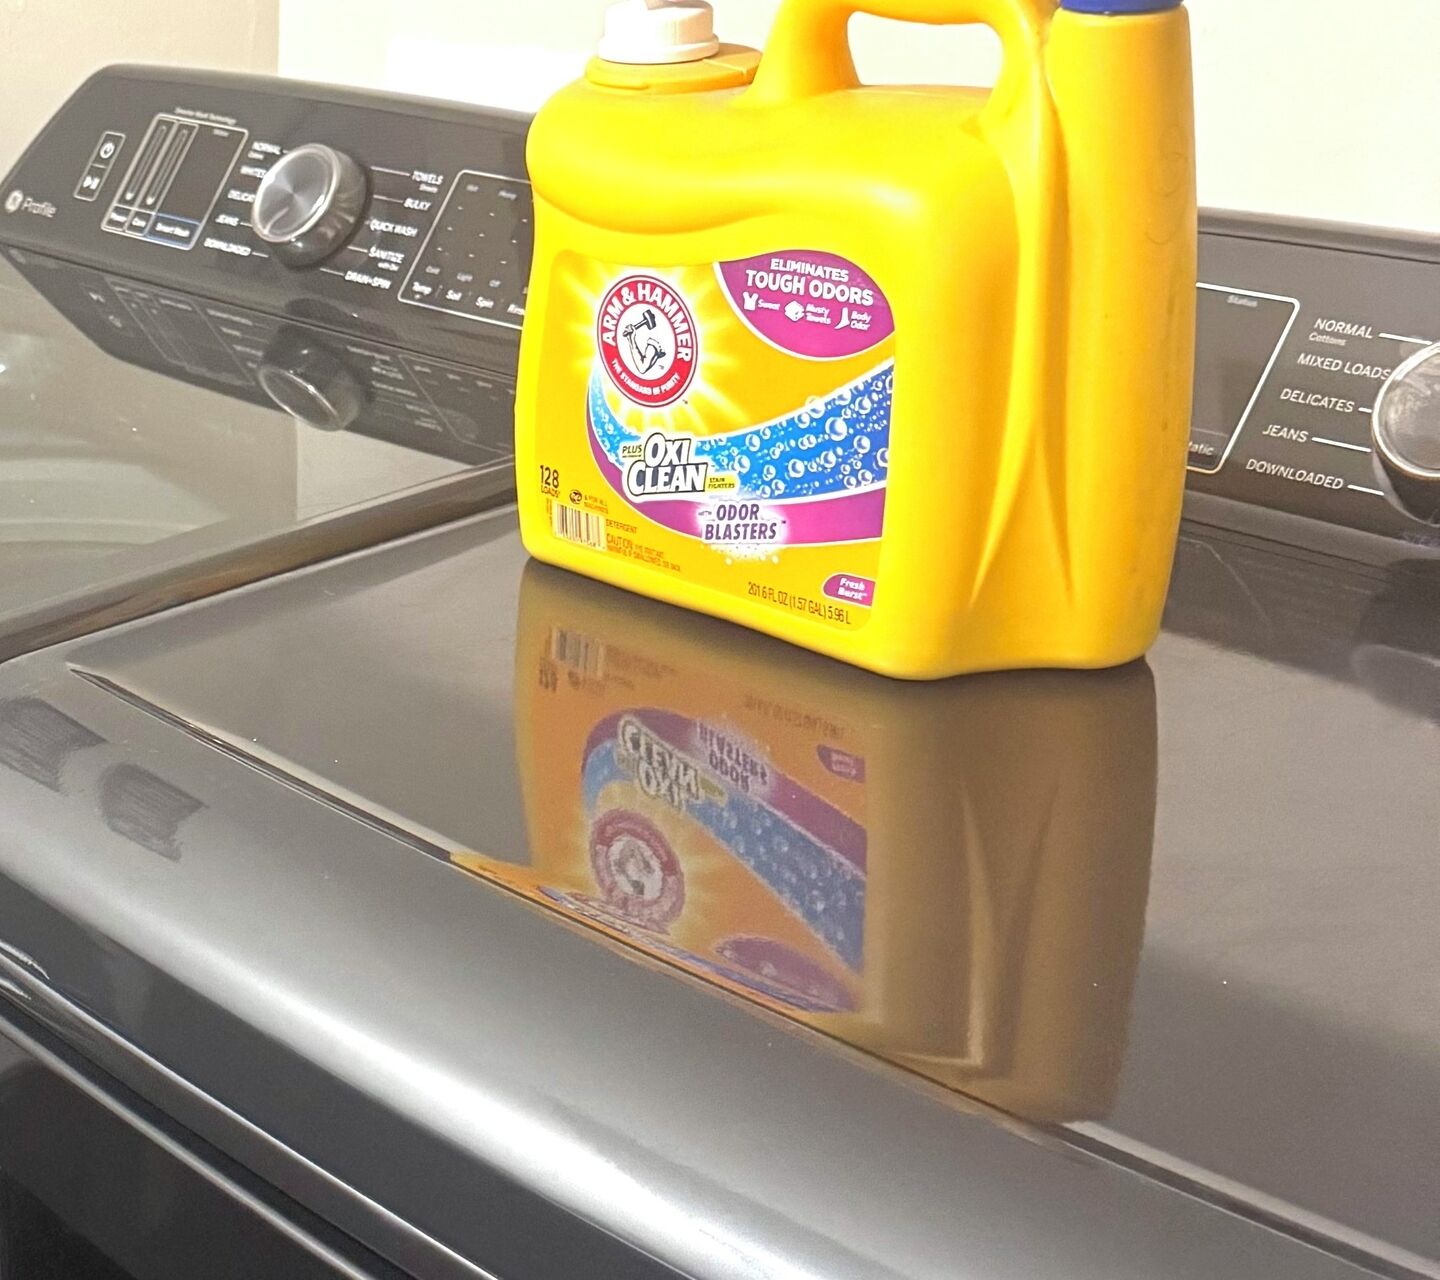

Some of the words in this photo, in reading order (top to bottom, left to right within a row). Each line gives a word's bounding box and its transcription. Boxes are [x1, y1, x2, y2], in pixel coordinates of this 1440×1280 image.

[770, 258, 849, 282] ELIMINATES
[746, 269, 806, 295] TOUGH
[809, 280, 874, 306] ODORS
[602, 296, 624, 346] ARM
[620, 286, 637, 306] &
[637, 282, 693, 362] HAMMER
[1313, 318, 1373, 339] NORMAL
[1297, 352, 1342, 372] MIXED
[1344, 362, 1392, 381] LOADS
[1280, 388, 1355, 413] DELICATES
[1262, 424, 1309, 443] JEANS
[622, 444, 643, 454] PLUS
[644, 432, 692, 468] OXI
[540, 464, 559, 489] 128
[628, 460, 709, 496] CLEAN
[1246, 458, 1343, 490] DOWNLOADED
[716, 503, 760, 520] ODOR
[704, 522, 777, 540] BLASTERS
[768, 588, 777, 602] FL
[839, 577, 866, 591] Fresh
